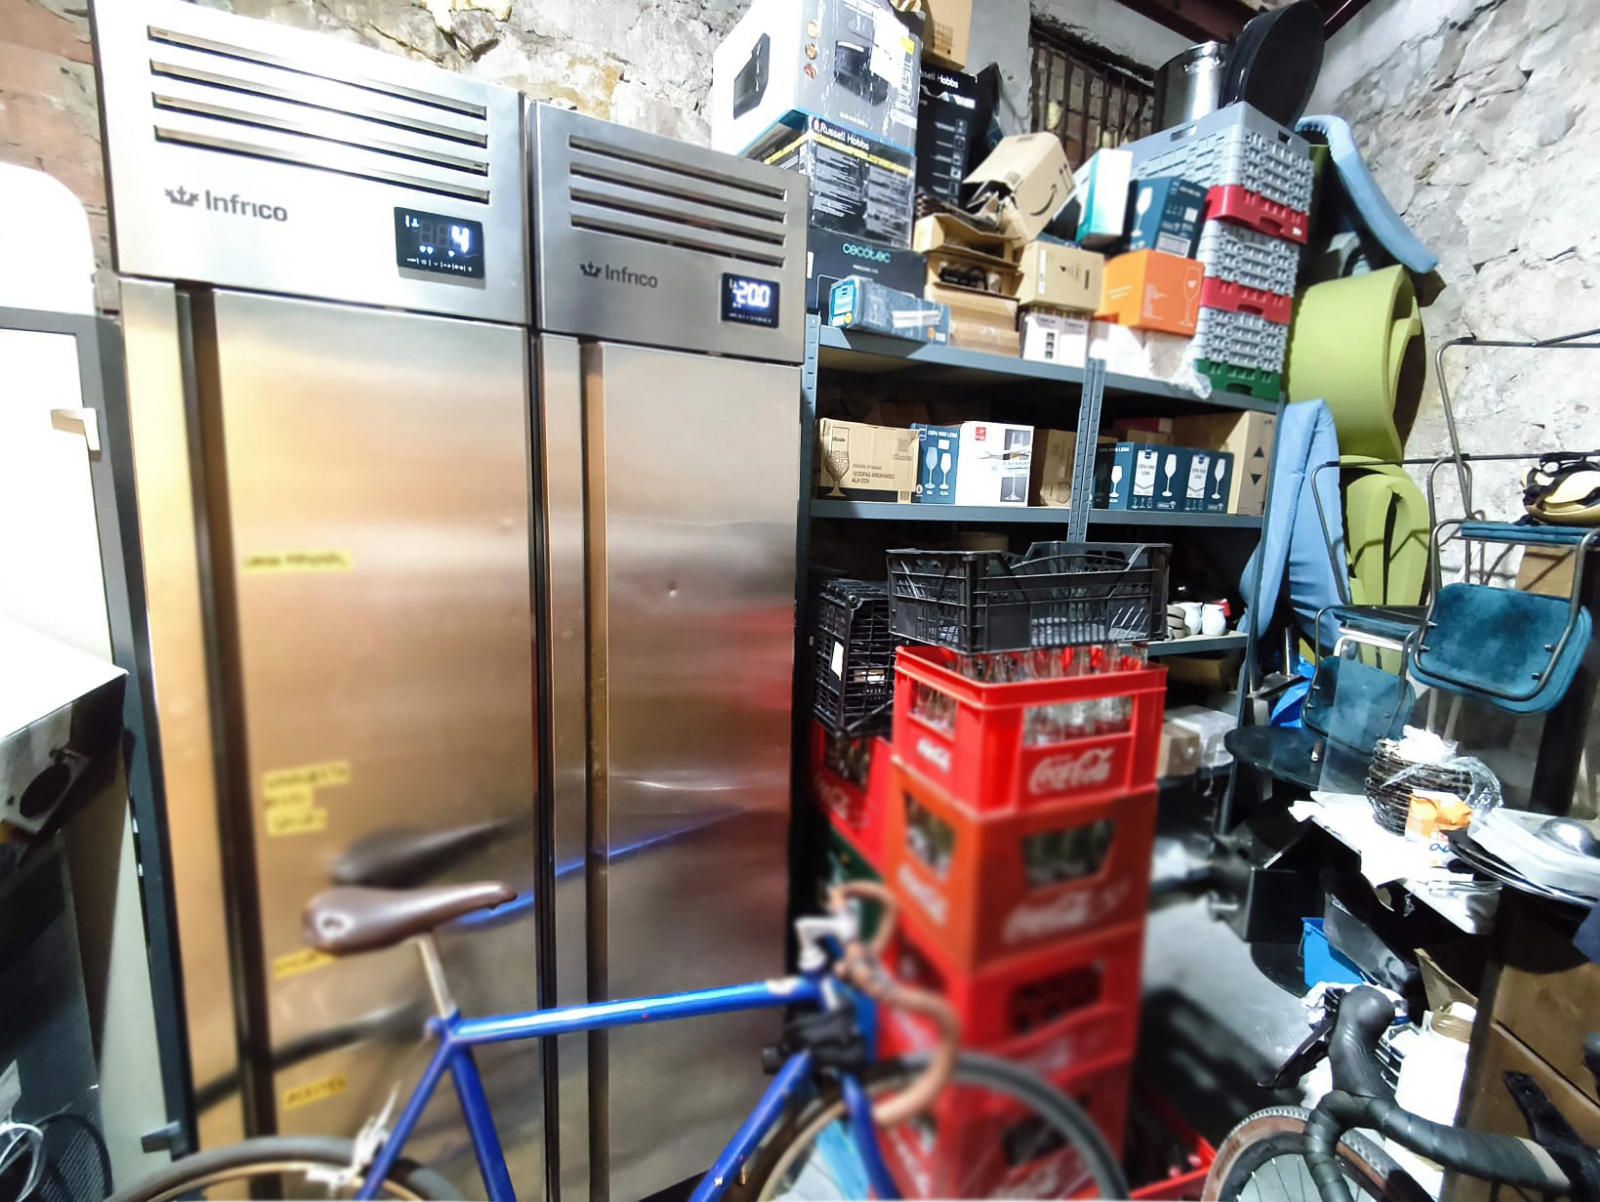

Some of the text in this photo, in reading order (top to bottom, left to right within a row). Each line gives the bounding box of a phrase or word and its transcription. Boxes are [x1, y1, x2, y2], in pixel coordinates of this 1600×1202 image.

[937, 74, 959, 88] Hobbs
[820, 122, 870, 151] Russell Hobbs
[205, 189, 288, 222] Infrico
[452, 224, 470, 253] 4
[842, 243, 892, 264] cecotec
[605, 263, 659, 289] Infrico
